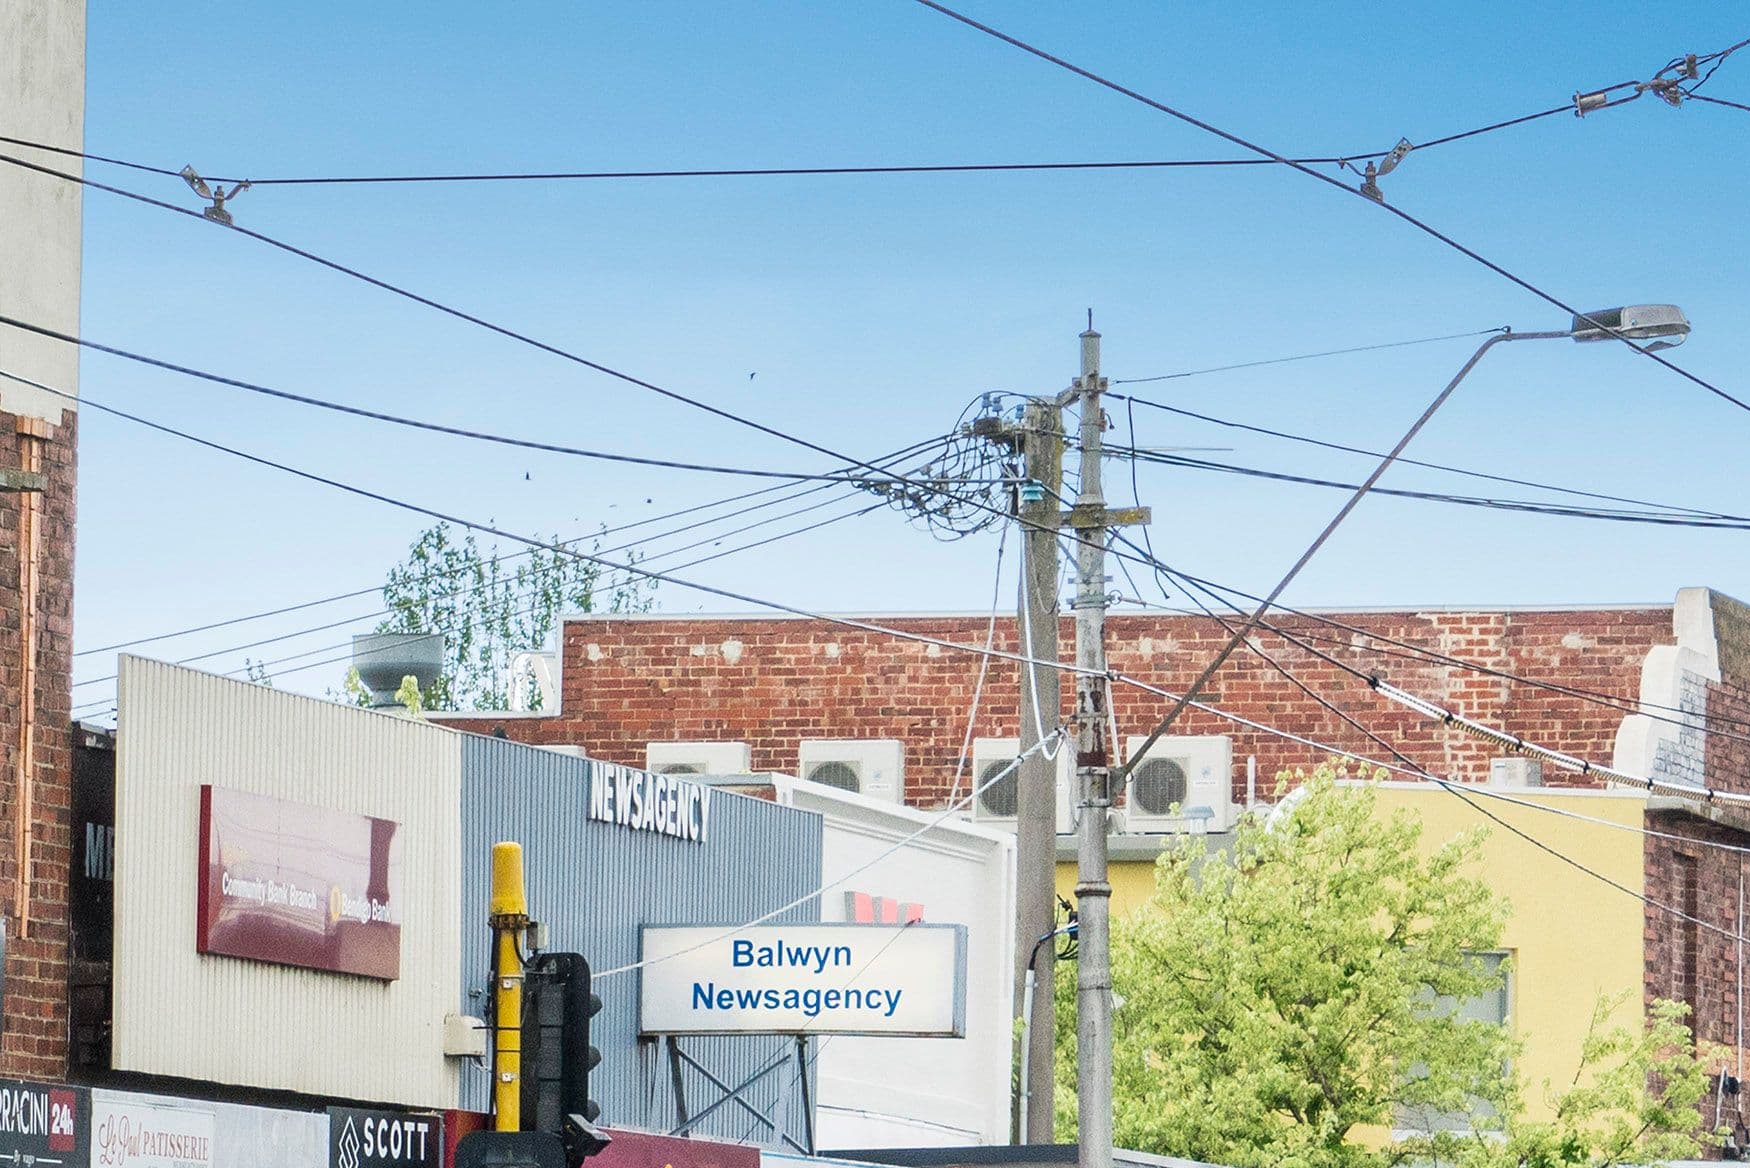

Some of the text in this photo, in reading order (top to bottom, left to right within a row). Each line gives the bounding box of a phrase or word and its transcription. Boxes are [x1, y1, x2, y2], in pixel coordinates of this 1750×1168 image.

[591, 761, 711, 842] NEWSAGENCY
[372, 898, 392, 922] Bank
[732, 939, 852, 974] Balwyn
[691, 982, 903, 1017] Newsagency
[51, 1103, 74, 1136] 24h
[143, 1130, 209, 1162] PATISSERIE
[363, 1117, 430, 1161] SCOTT
